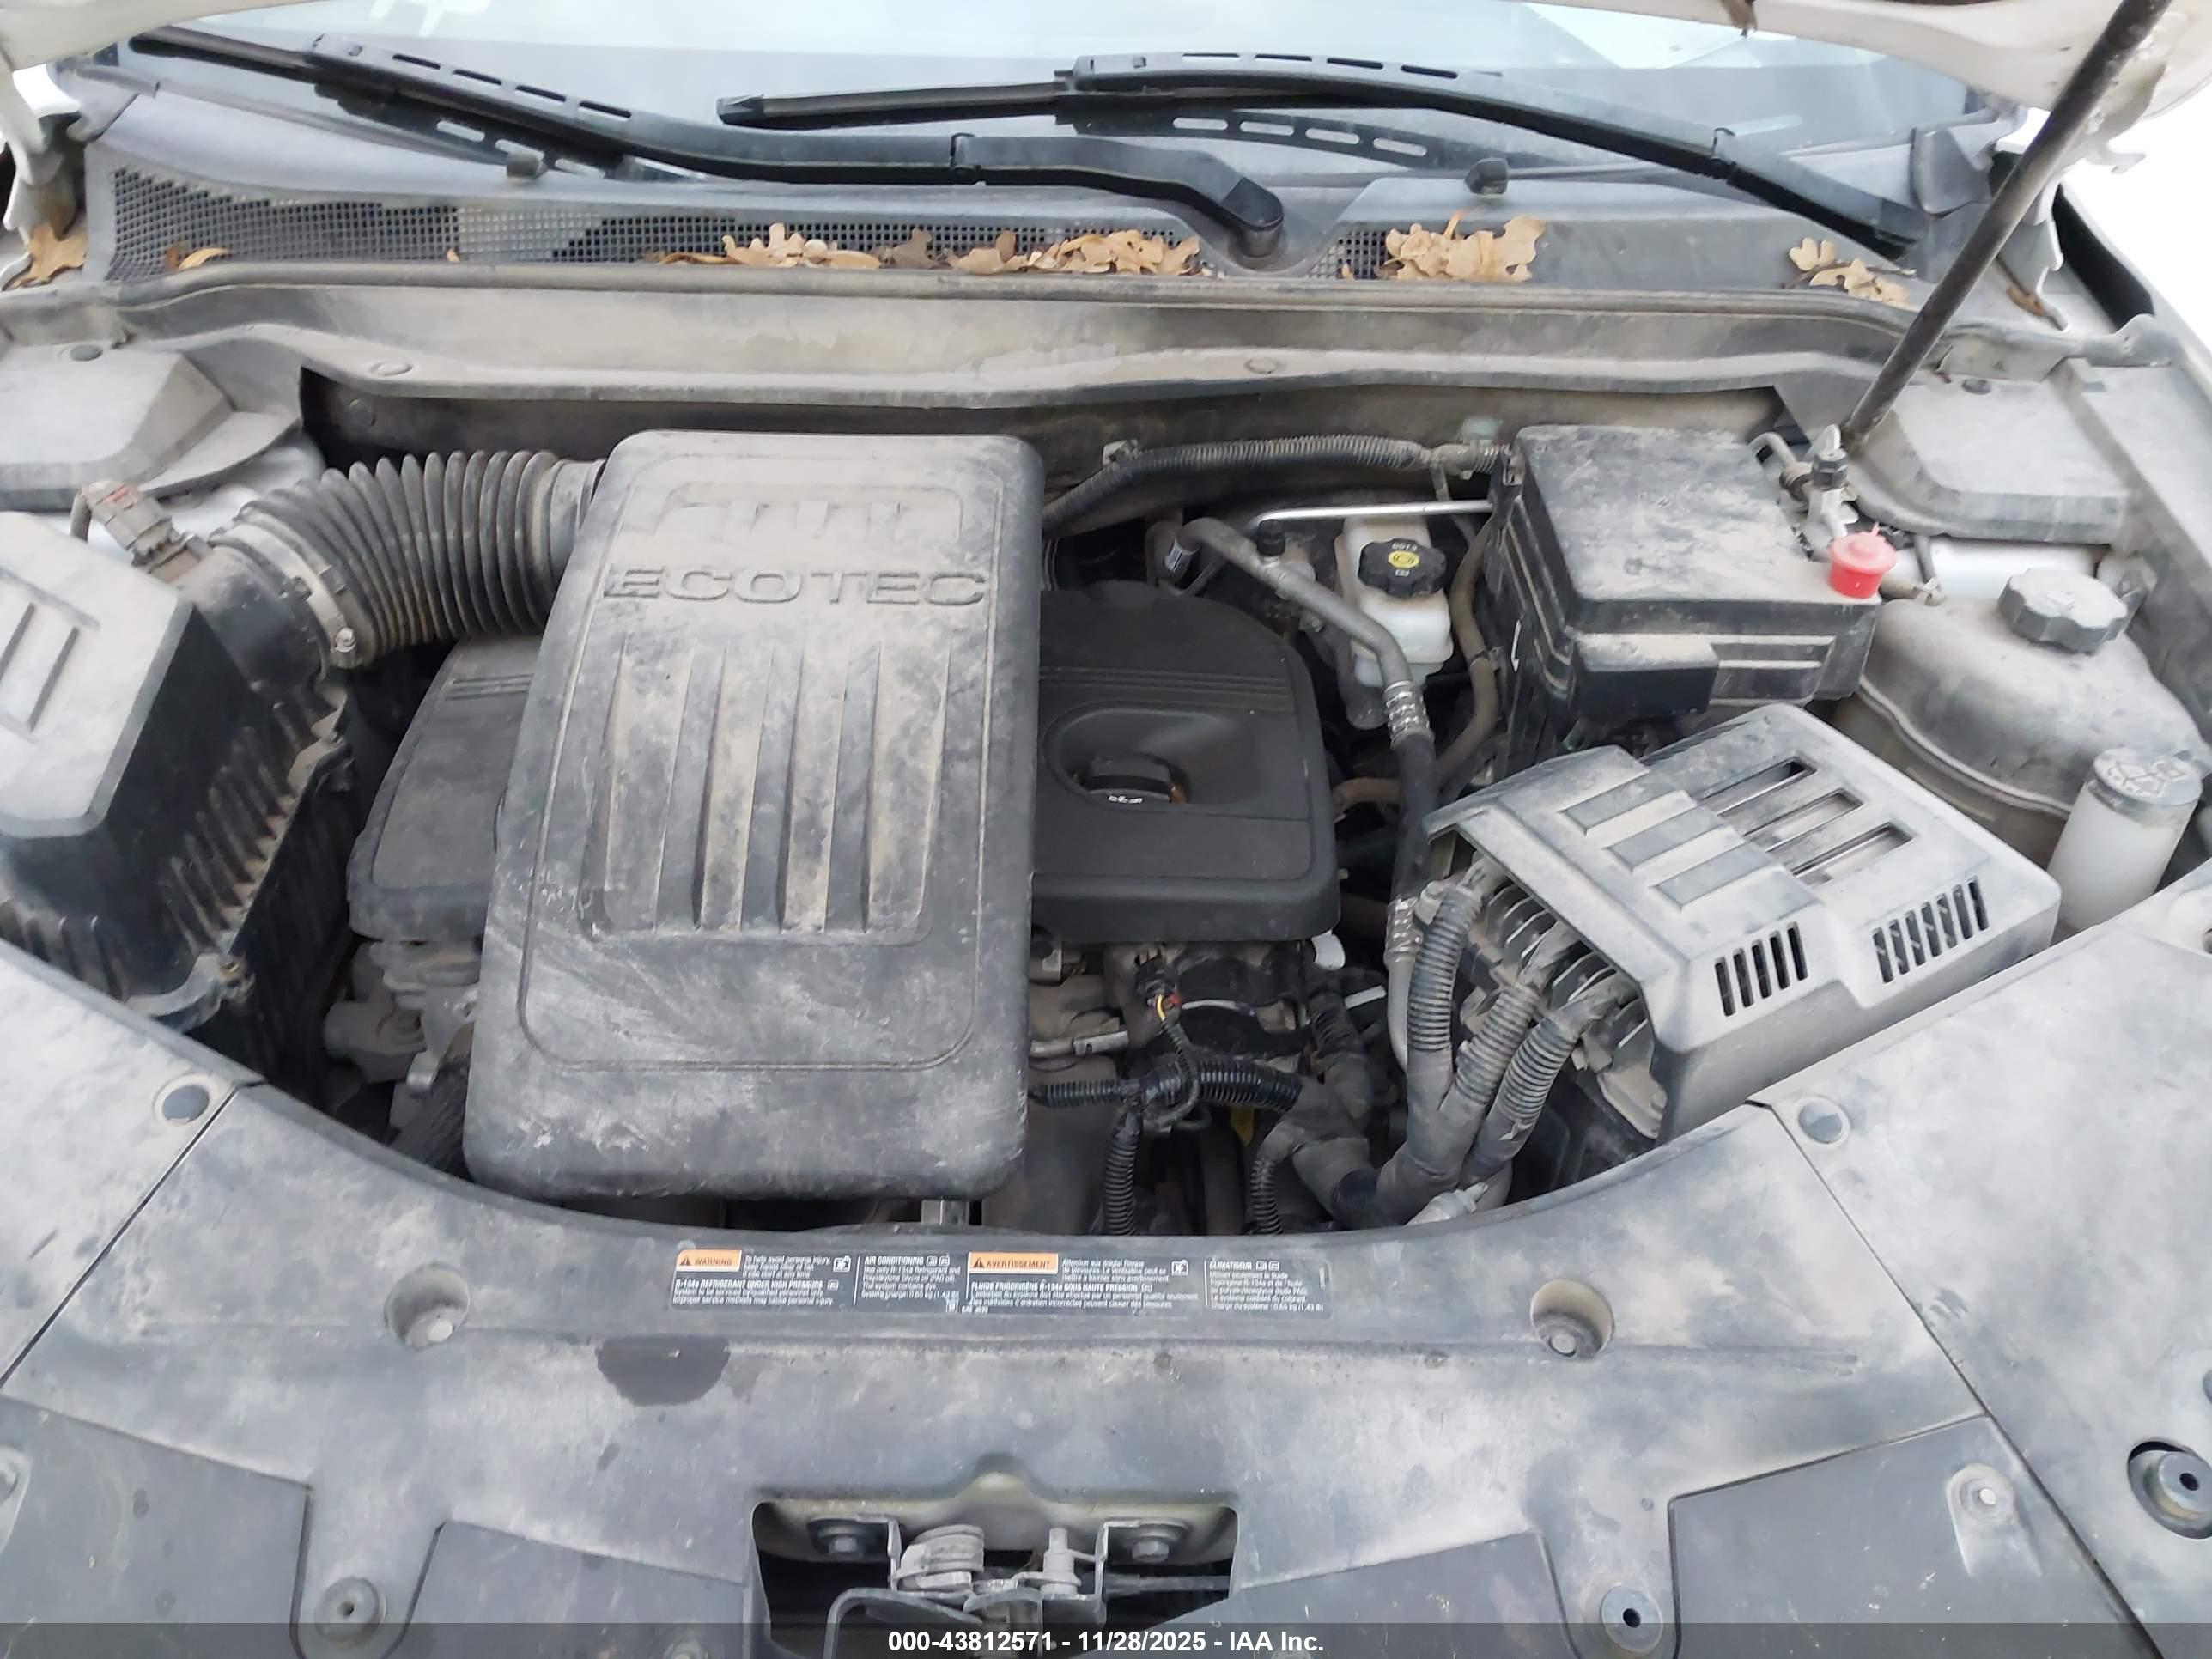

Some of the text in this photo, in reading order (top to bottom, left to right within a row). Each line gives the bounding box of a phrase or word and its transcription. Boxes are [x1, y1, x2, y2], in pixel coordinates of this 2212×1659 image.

[604, 567, 986, 605] ECOTEC
[696, 1257, 732, 1267] WARNING
[865, 1256, 877, 1265] AIR
[987, 1260, 1050, 1268] AVERTISSEMENT
